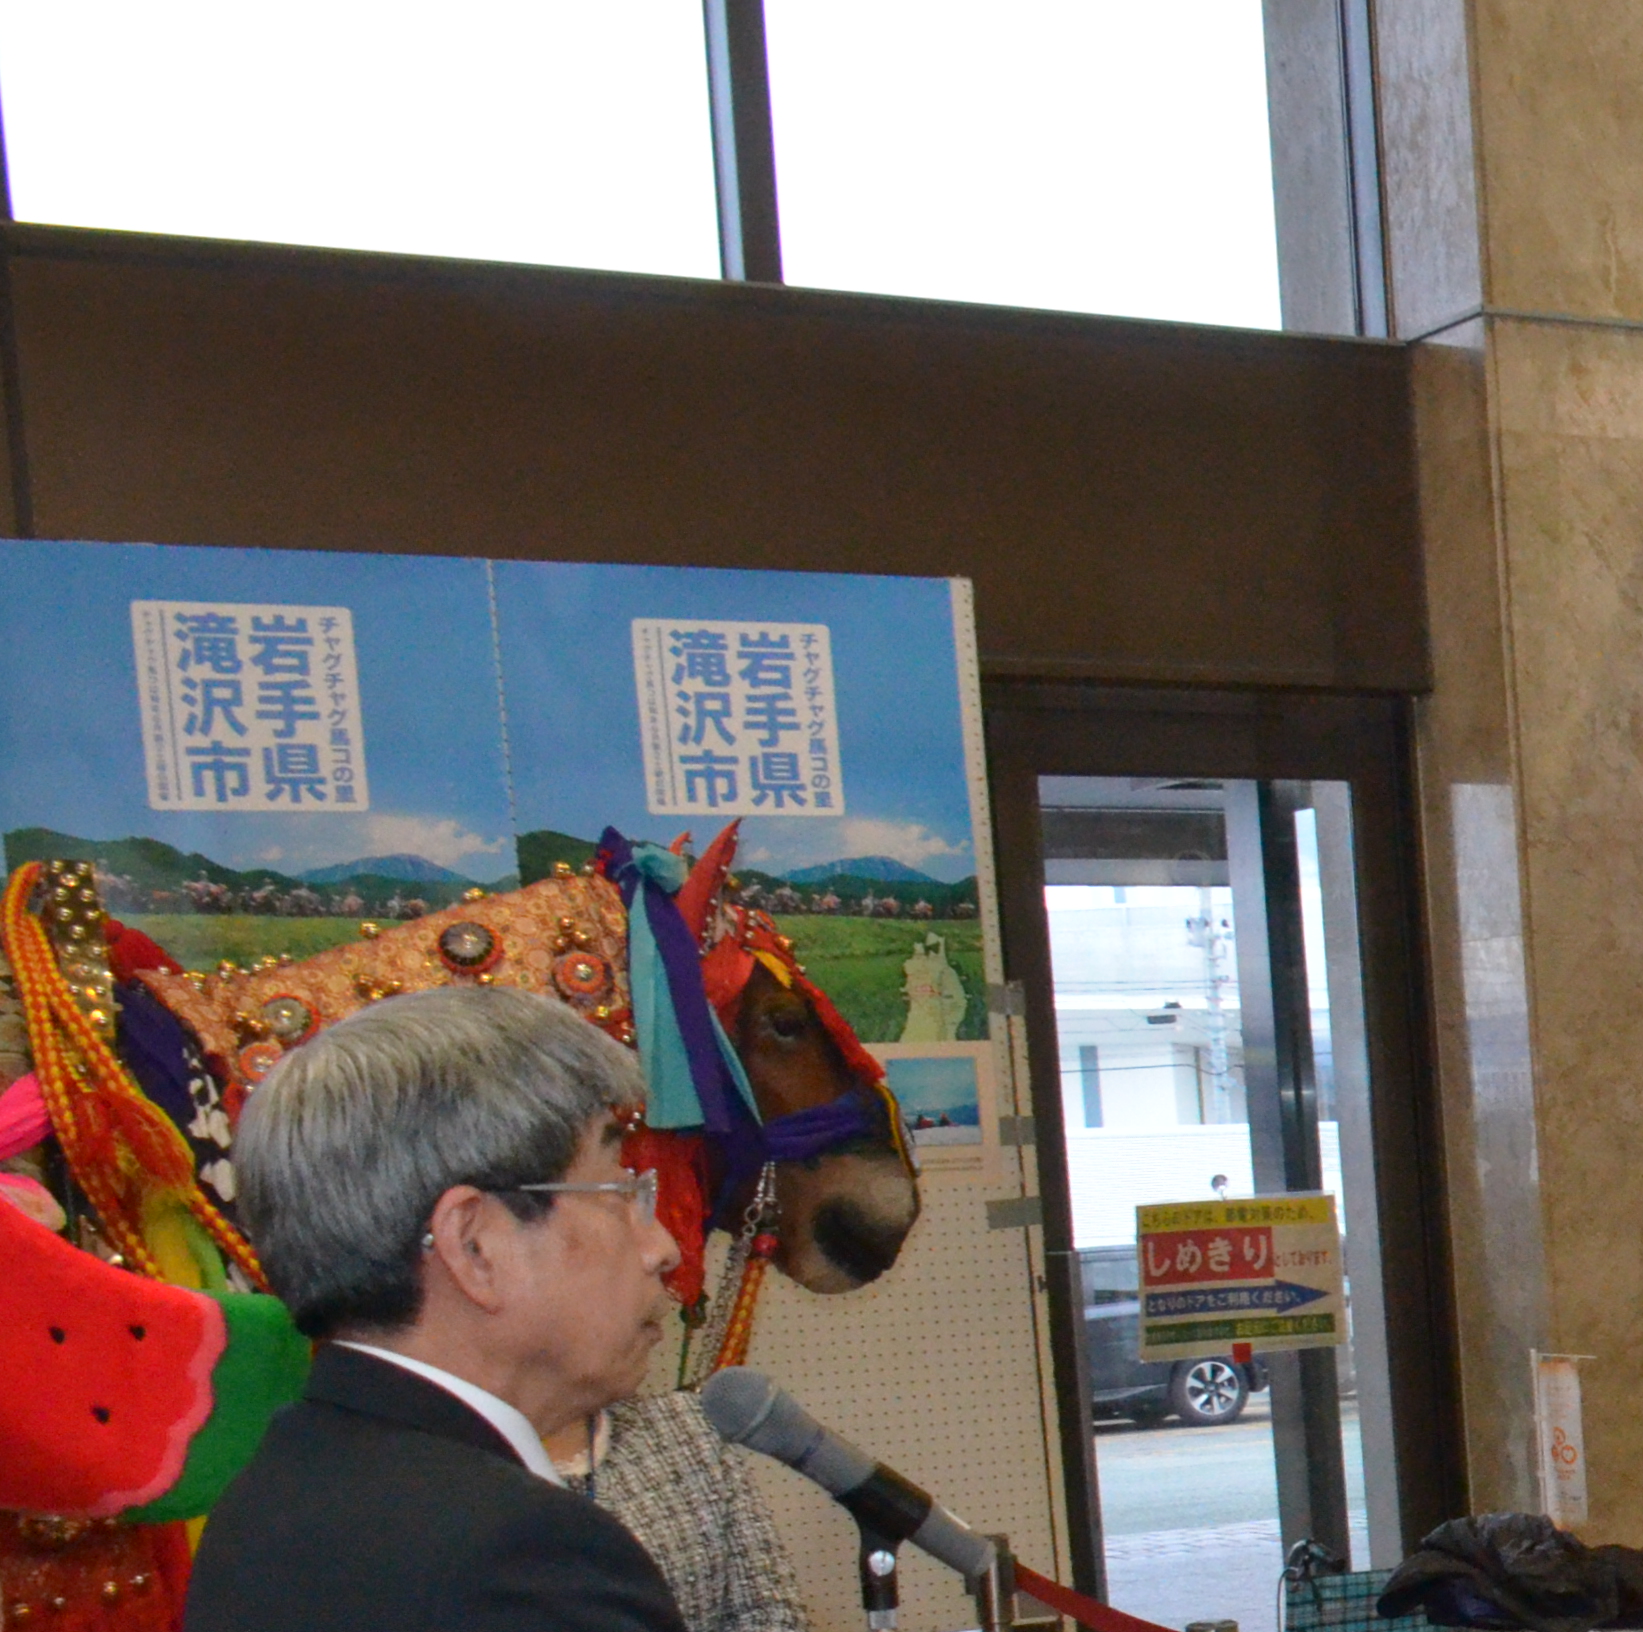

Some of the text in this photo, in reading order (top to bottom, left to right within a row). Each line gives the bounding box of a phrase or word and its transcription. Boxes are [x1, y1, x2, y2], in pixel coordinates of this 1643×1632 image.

[173, 612, 252, 803] 滝沢市
[249, 614, 327, 804] 岩手県
[669, 629, 740, 808] 滝沢市
[736, 631, 807, 808] 岩手県
[1148, 1235, 1269, 1277] しめきり
